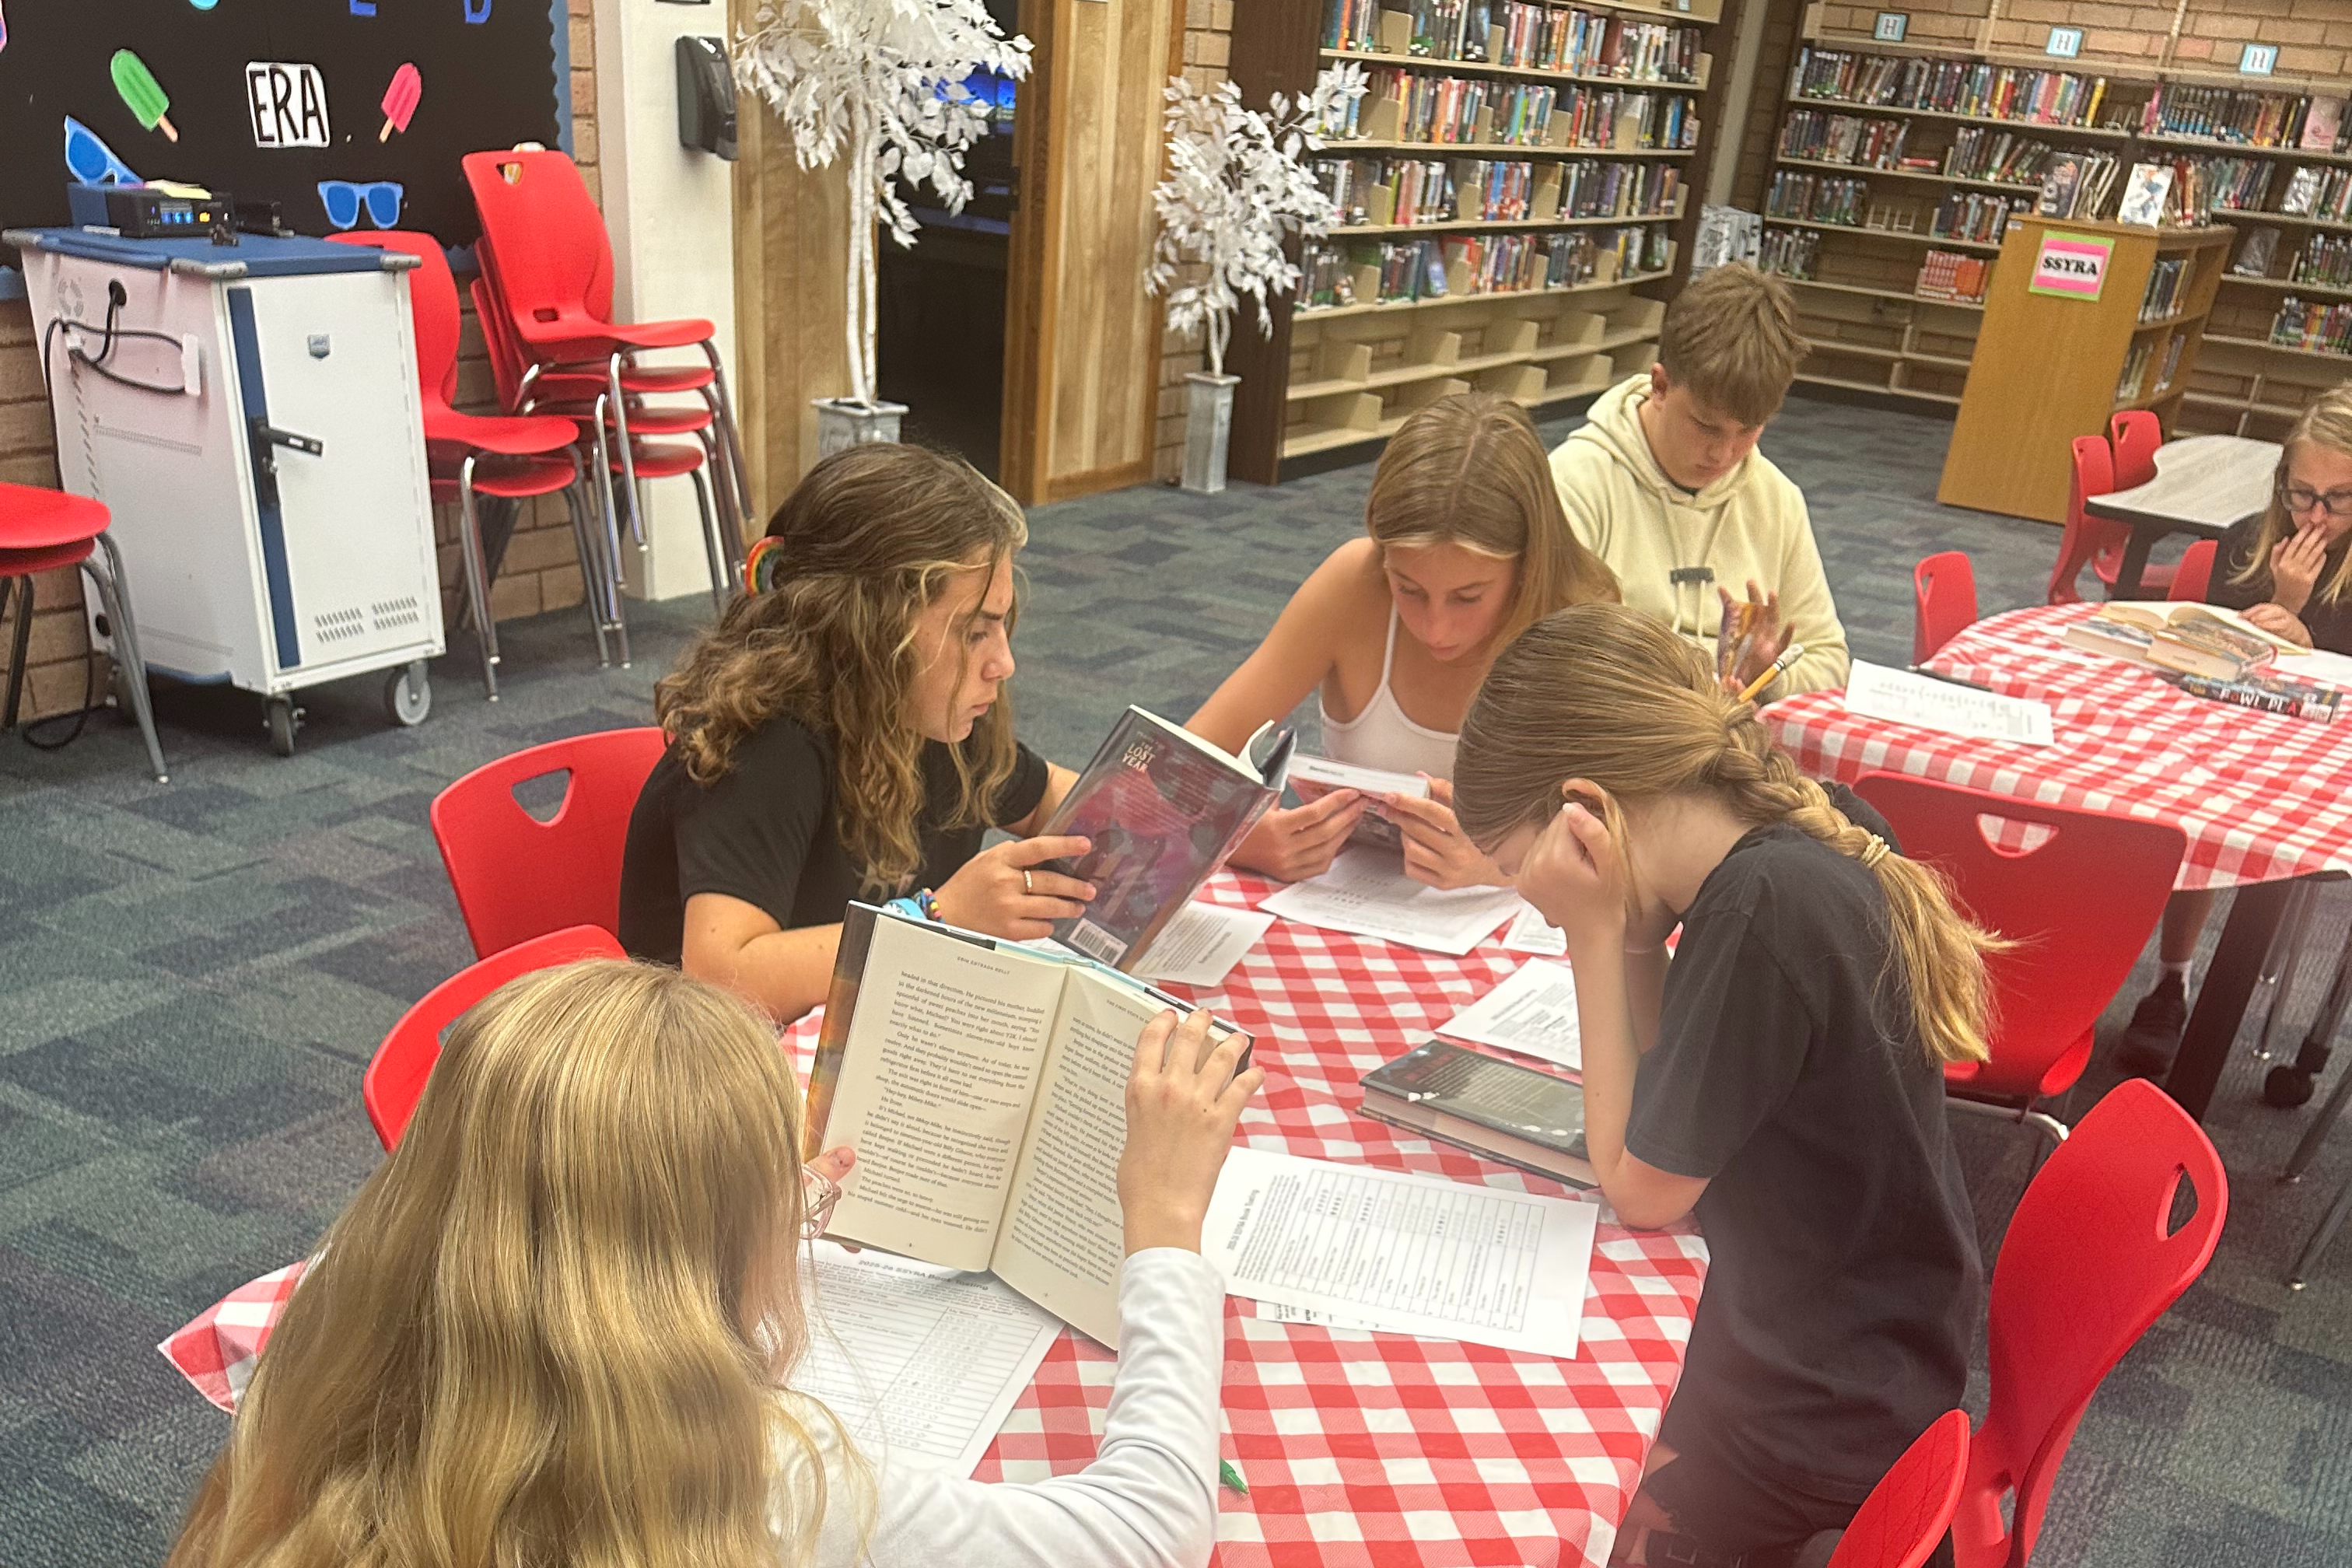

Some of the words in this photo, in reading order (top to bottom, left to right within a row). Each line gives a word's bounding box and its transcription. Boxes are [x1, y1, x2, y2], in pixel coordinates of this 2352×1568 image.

[249, 68, 327, 143] ERA
[2042, 255, 2098, 276] SSYRA
[1122, 753, 1148, 773] YEAR
[1128, 743, 1156, 764] LOST
[1240, 1208, 1251, 1220] Book
[858, 1259, 894, 1272] 2025-26
[927, 1272, 953, 1284] Book
[955, 1278, 989, 1291] Tasting
